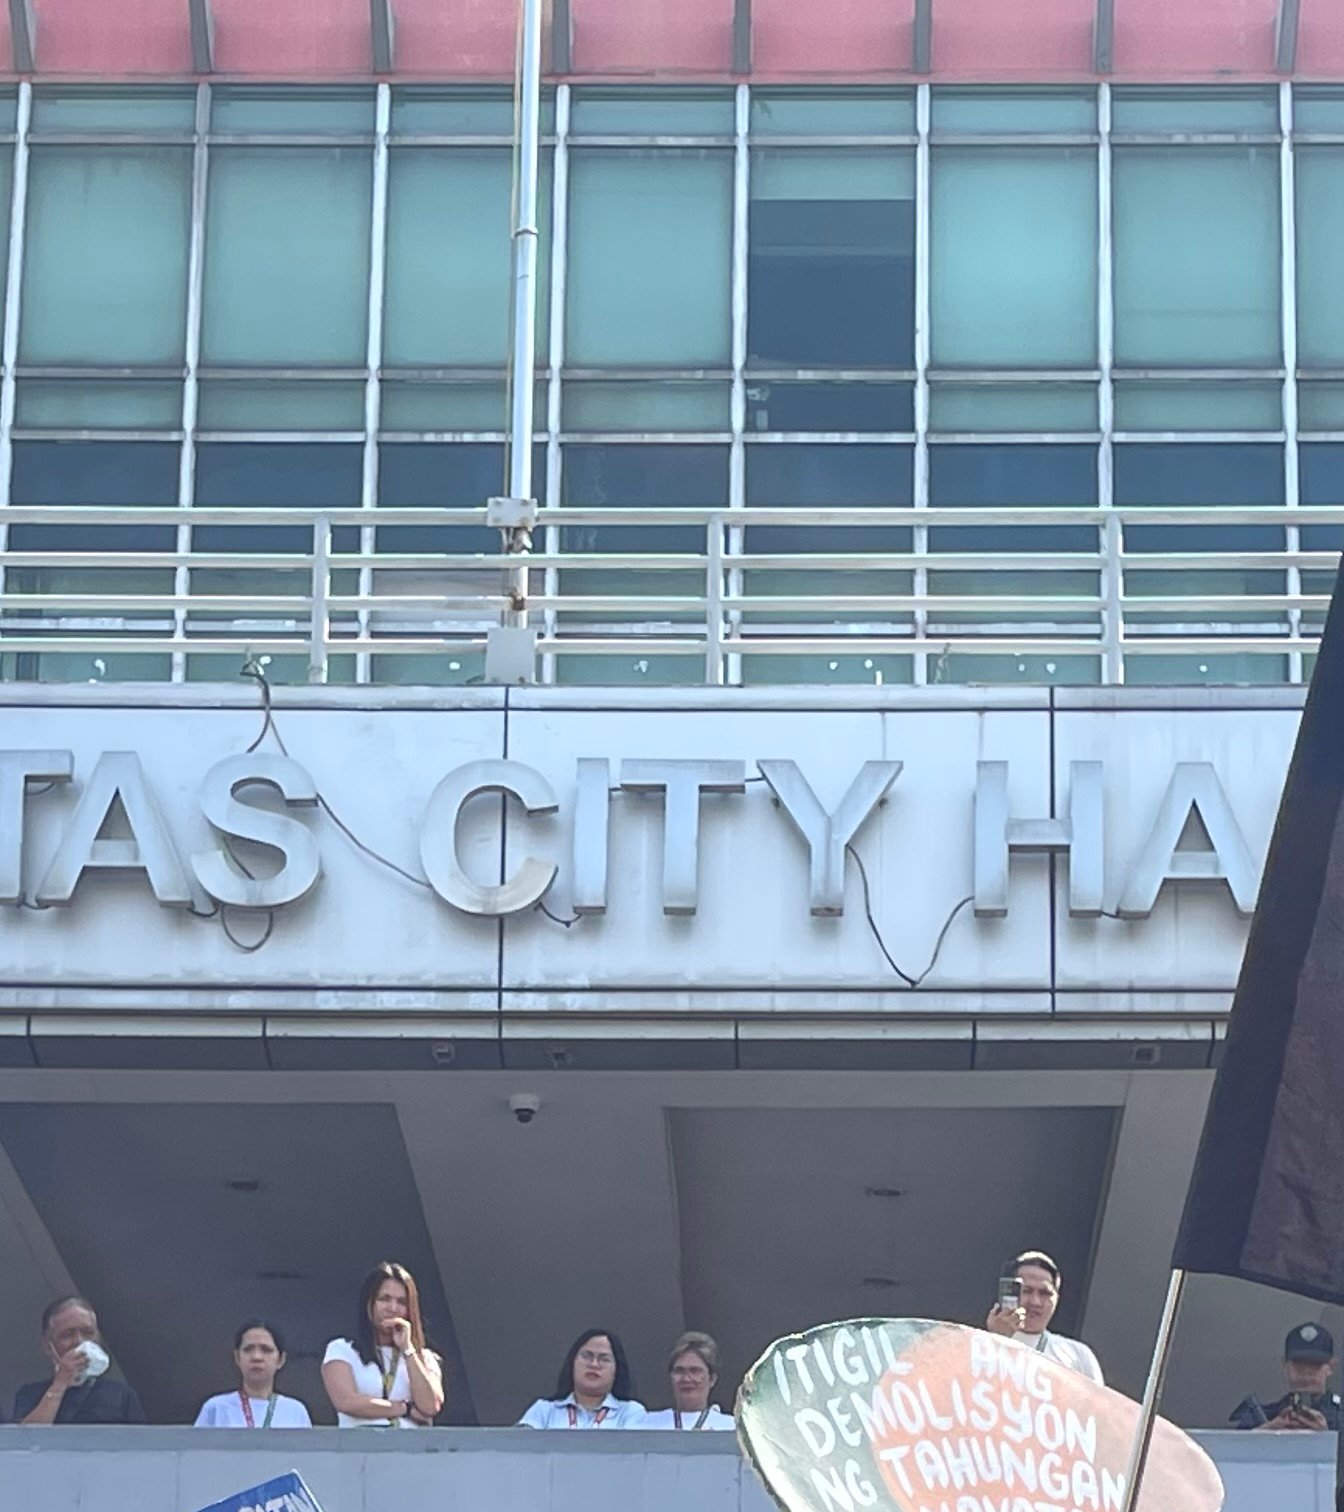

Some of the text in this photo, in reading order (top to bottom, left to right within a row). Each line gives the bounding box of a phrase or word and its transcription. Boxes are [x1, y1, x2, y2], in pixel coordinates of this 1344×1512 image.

[418, 756, 904, 920] CITY
[973, 759, 1259, 921] HA
[773, 1325, 1055, 1406] ITIGIL ANG
[793, 1378, 1099, 1466] DEMOLISYON
[879, 1436, 1127, 1512] TAHUNGAN
